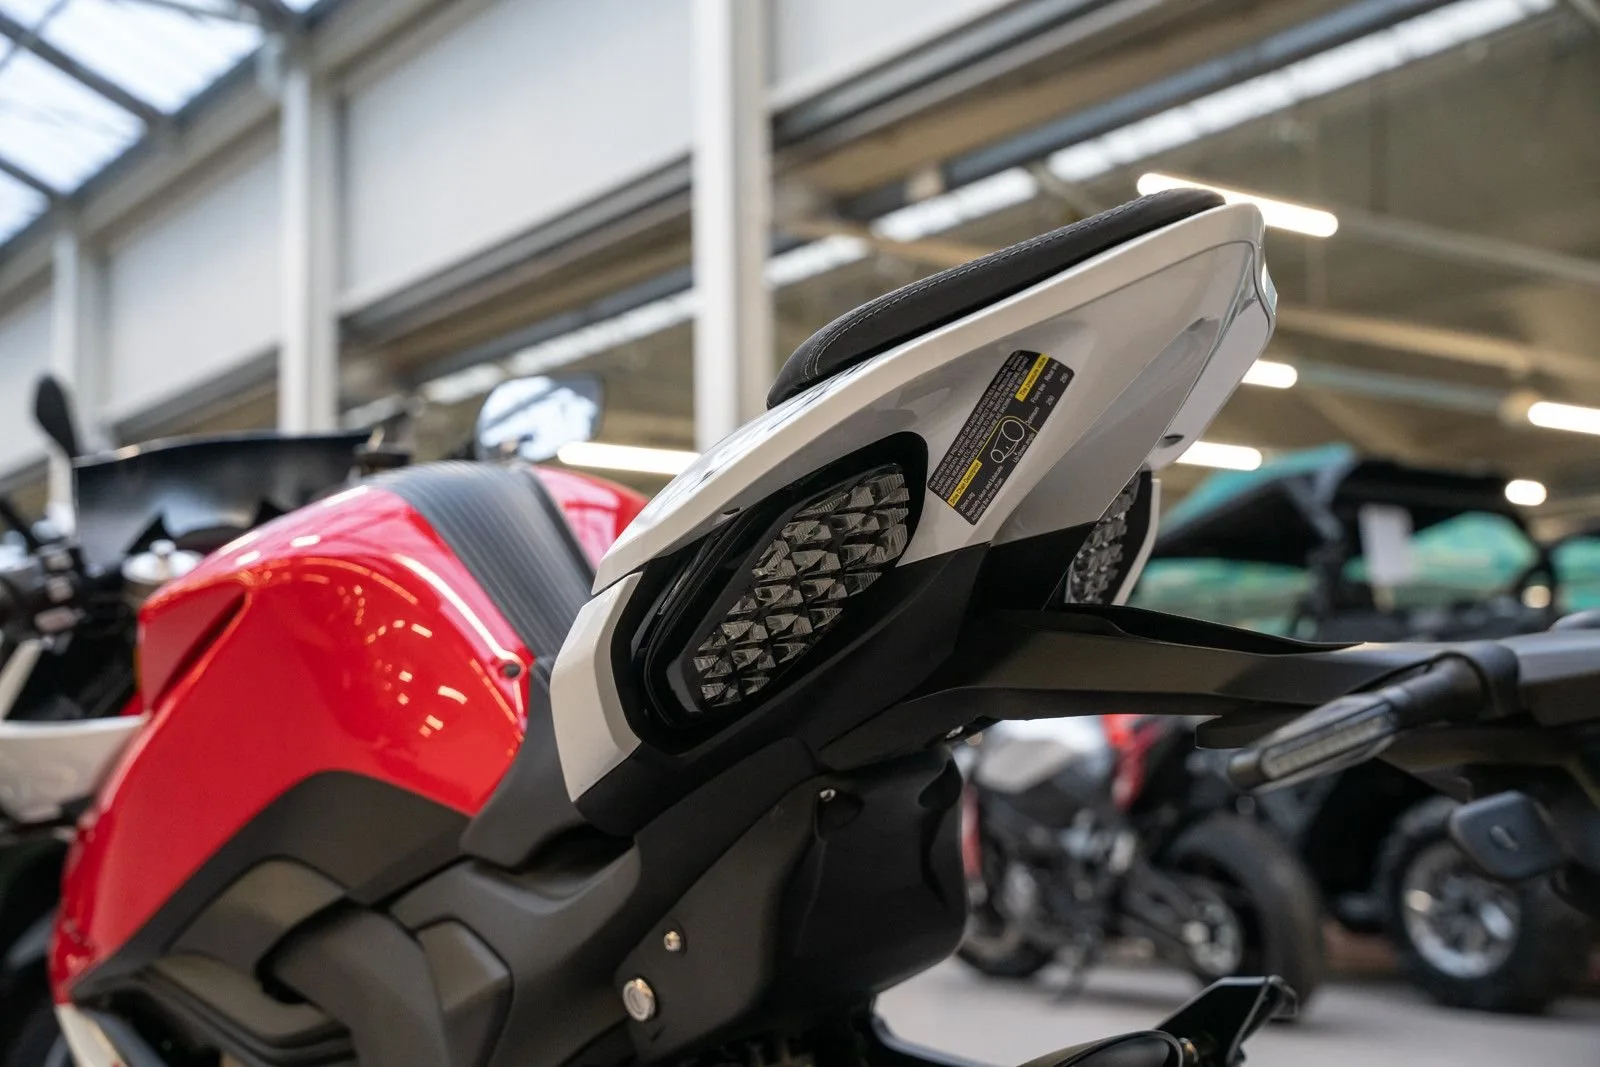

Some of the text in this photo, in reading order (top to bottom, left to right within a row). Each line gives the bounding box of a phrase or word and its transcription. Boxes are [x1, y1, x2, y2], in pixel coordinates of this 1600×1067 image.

[1029, 389, 1041, 403] Front
[983, 419, 989, 427] TO
[949, 492, 959, 504] Drive
[955, 481, 966, 494] Chain
[962, 461, 980, 484] Description
[977, 488, 987, 500] clean
[984, 480, 992, 490] and
[989, 464, 1003, 482] lubricate
